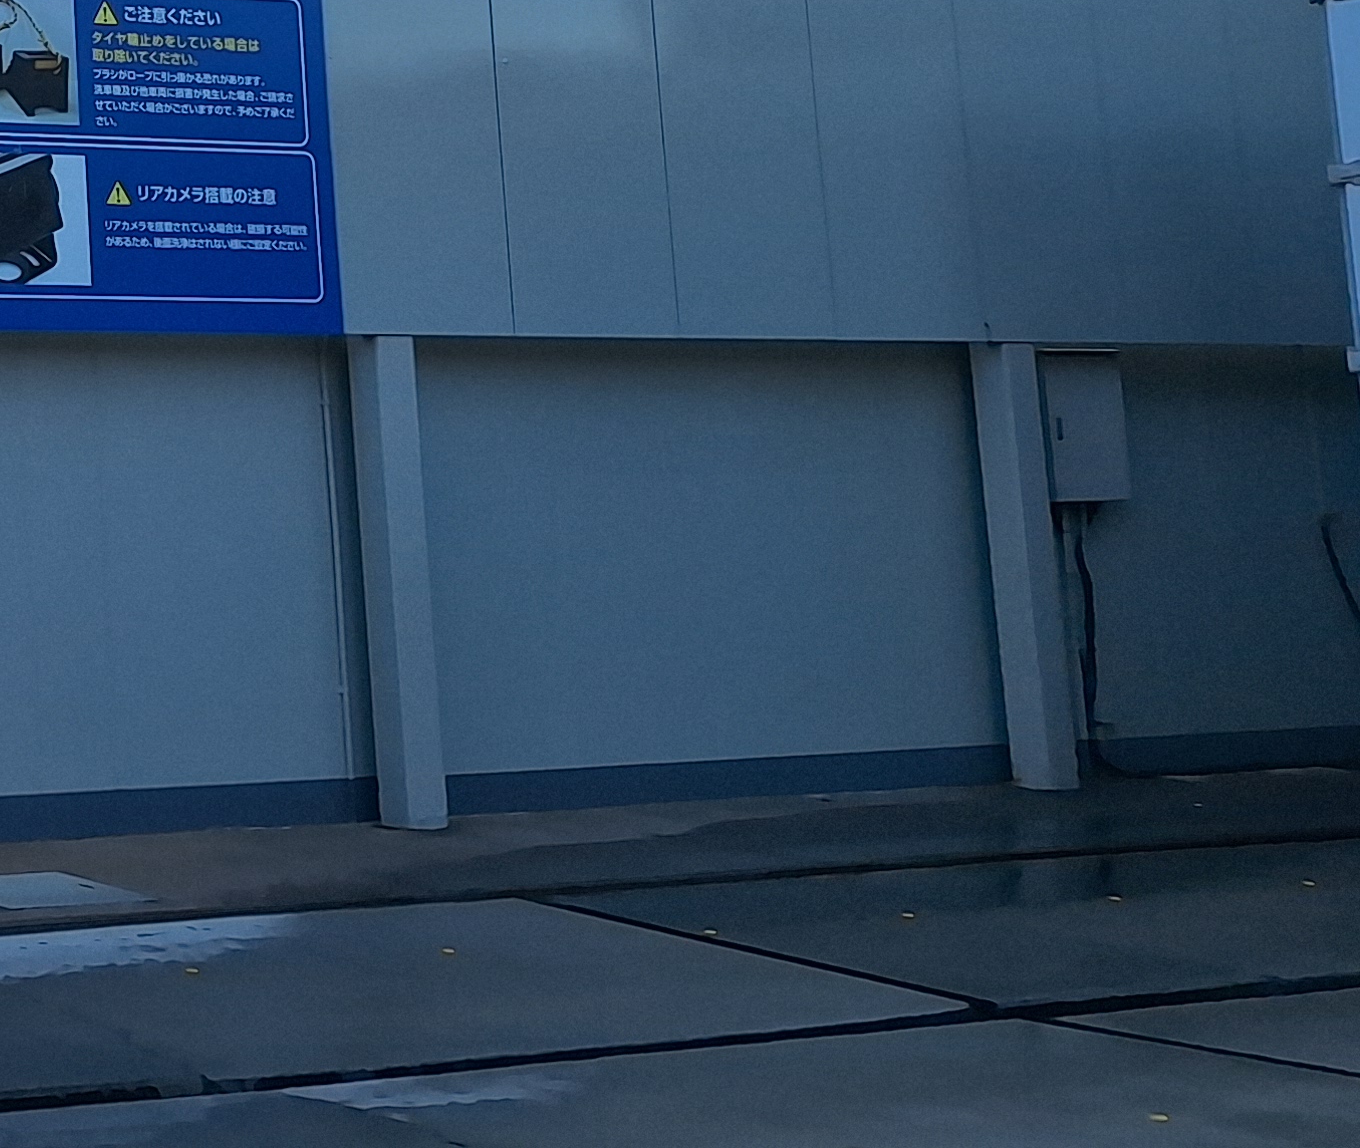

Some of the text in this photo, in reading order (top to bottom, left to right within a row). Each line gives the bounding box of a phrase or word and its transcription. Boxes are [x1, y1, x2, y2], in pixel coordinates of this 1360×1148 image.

[123, 5, 221, 26] ご注意ください
[137, 185, 277, 206] リアカメラ搭載の注意
